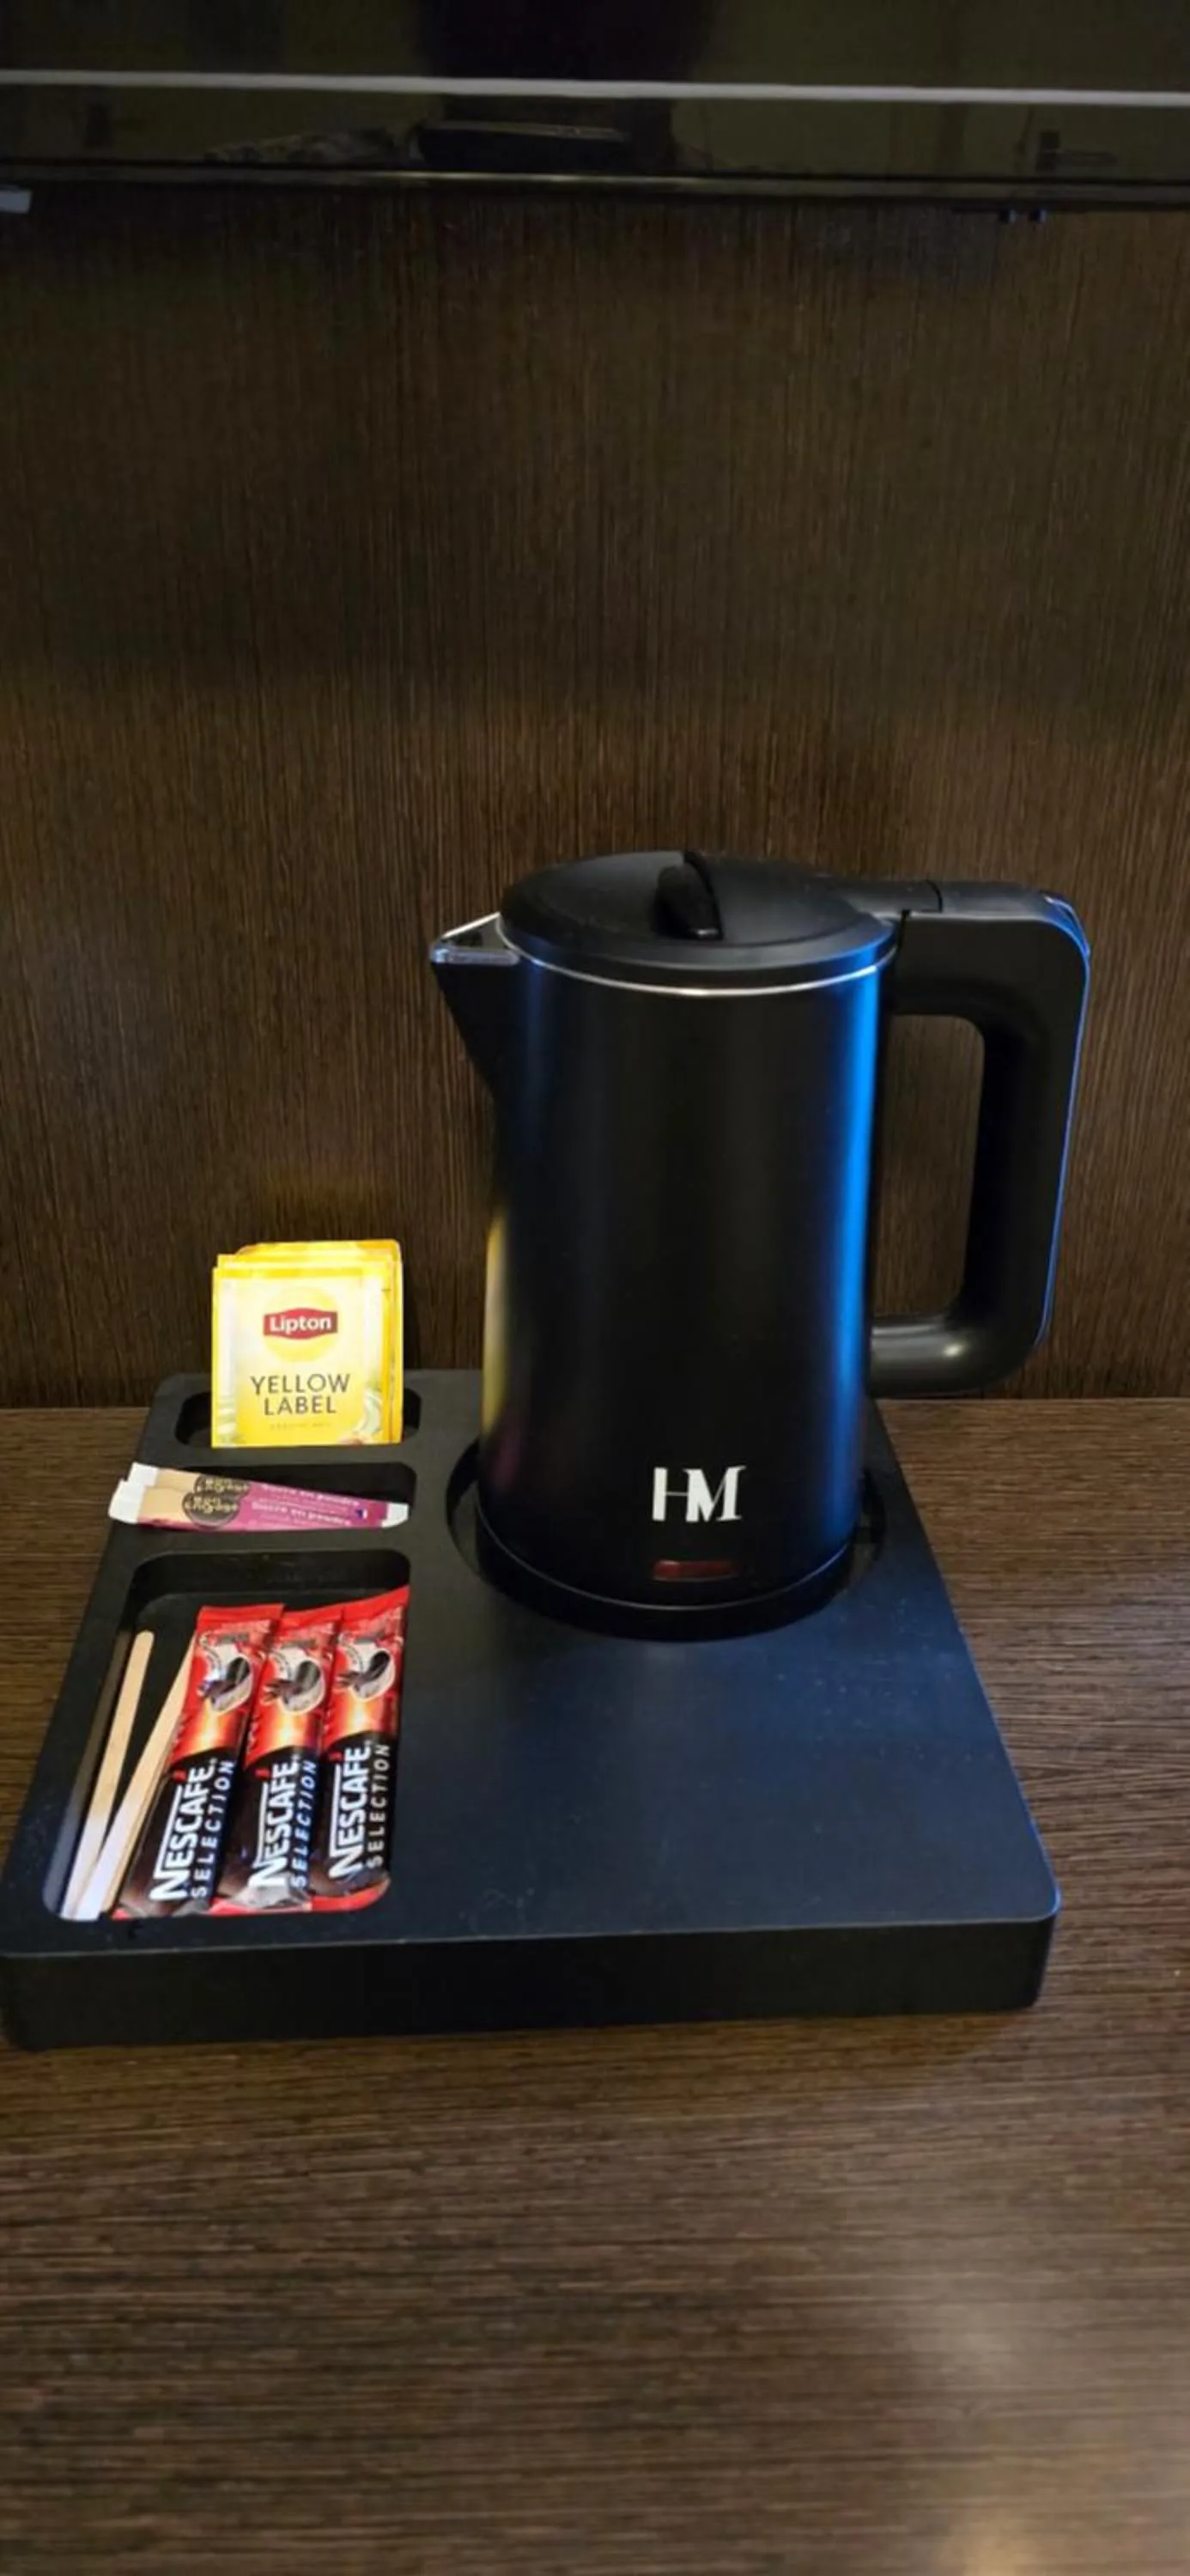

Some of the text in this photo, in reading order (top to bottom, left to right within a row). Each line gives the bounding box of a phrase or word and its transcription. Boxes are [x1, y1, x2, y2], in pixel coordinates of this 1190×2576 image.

[269, 1315, 332, 1334] Lipton
[250, 1373, 351, 1395] YELLOW
[264, 1394, 337, 1416] LABEL
[191, 1760, 236, 1899] SELECTION
[290, 1759, 318, 1889] SELECTION
[367, 1744, 391, 1869] SELECTION
